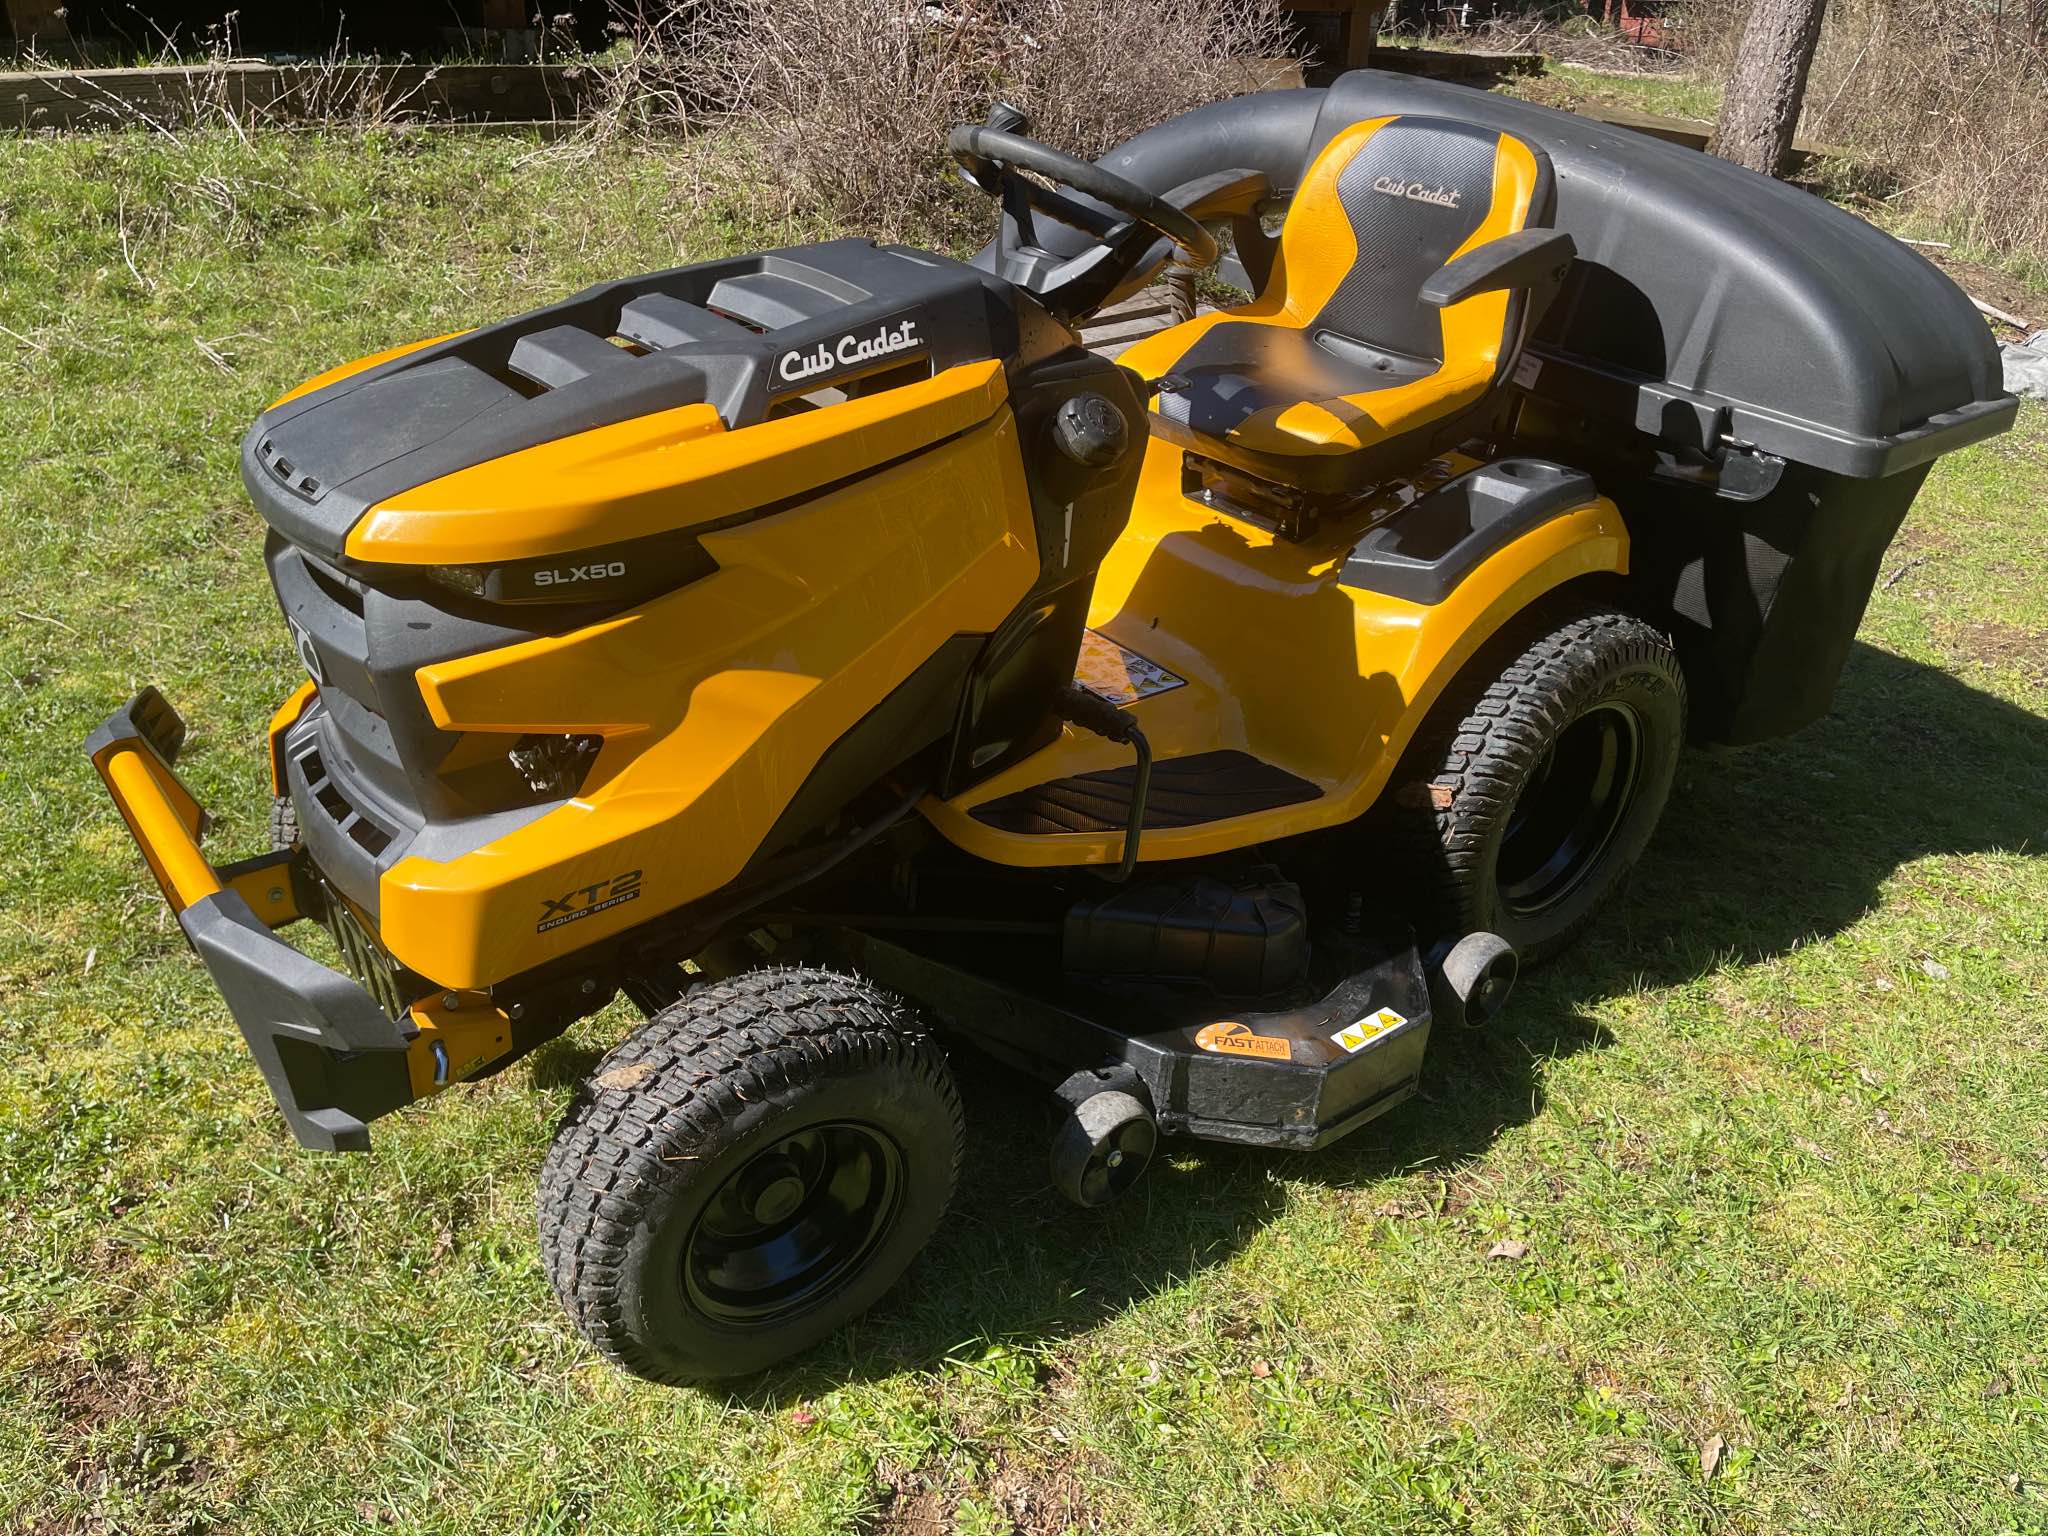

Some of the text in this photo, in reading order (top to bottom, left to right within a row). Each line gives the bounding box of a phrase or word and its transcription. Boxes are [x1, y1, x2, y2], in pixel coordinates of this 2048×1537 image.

[1373, 176, 1461, 209] Cub Cadet
[779, 320, 919, 382] Cub Cadet
[534, 561, 625, 586] SLX50
[539, 869, 643, 921] XT2
[539, 892, 635, 931] ENDURO SERIES
[1214, 1036, 1285, 1052] FAST ATTACH
